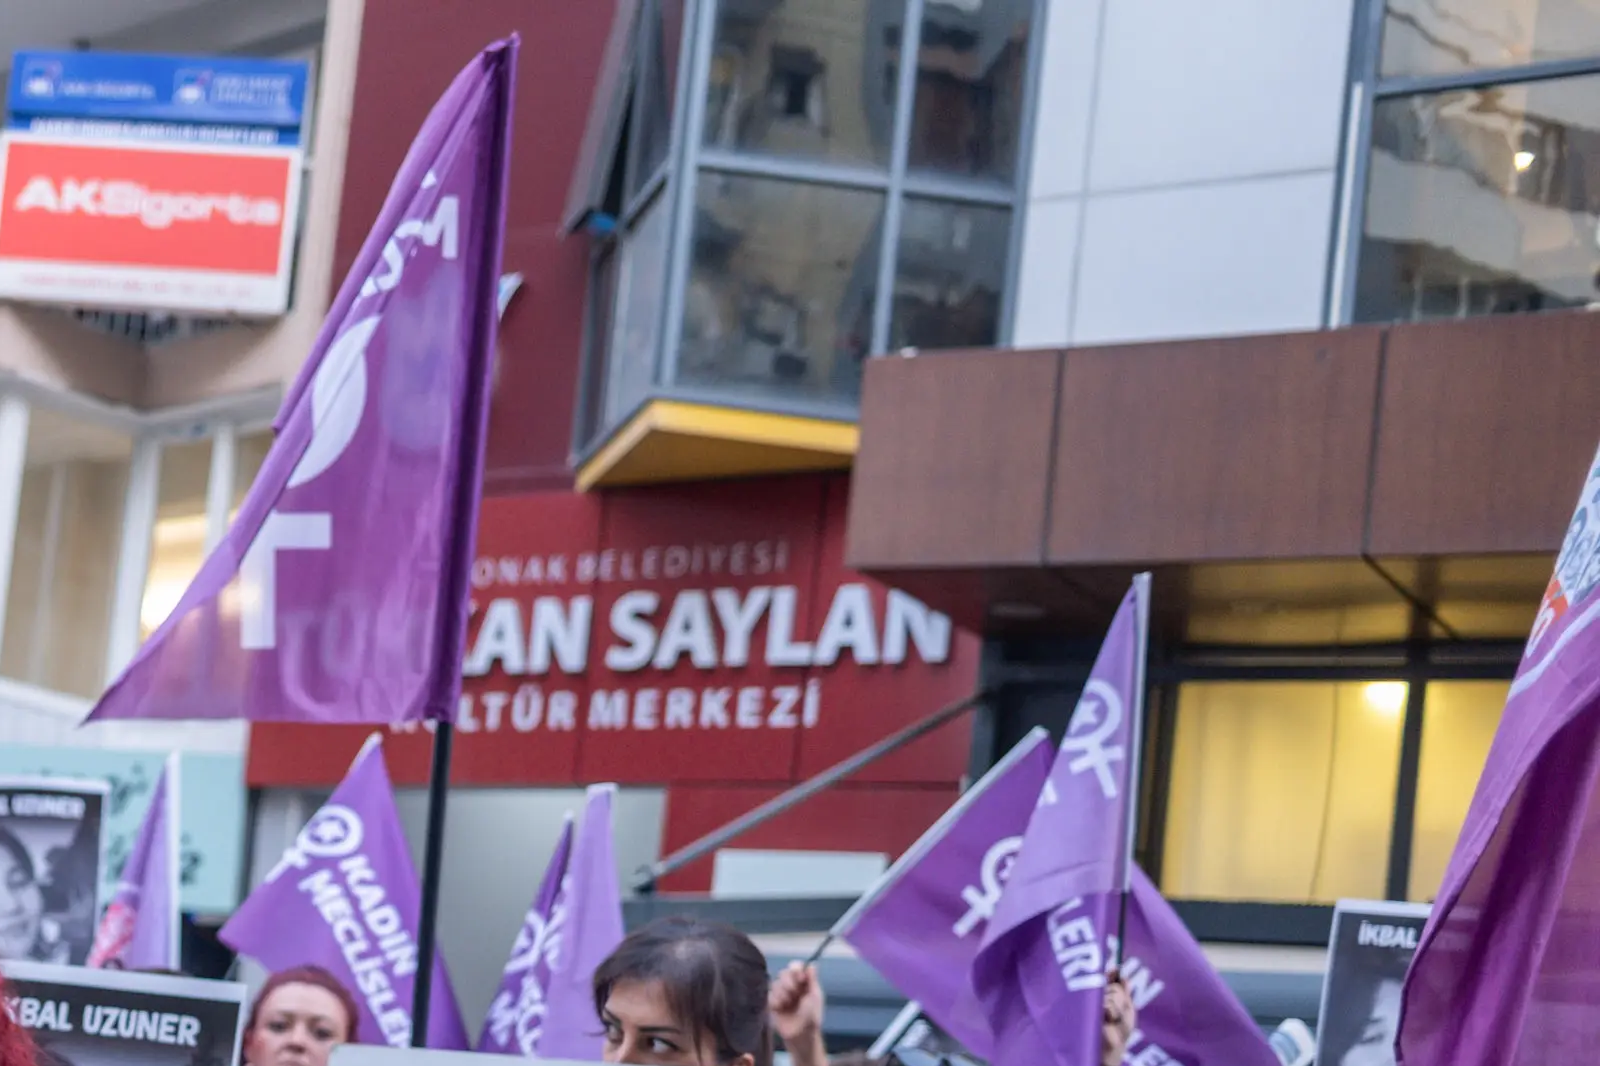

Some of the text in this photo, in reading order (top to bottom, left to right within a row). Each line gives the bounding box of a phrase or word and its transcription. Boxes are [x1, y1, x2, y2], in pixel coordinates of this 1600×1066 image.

[470, 554, 567, 589] ONAK
[605, 583, 953, 671] SAYLAN
[588, 678, 821, 731] MERKEZİ
[1357, 920, 1419, 949] İKBAL
[83, 1004, 201, 1047] UZUNER
